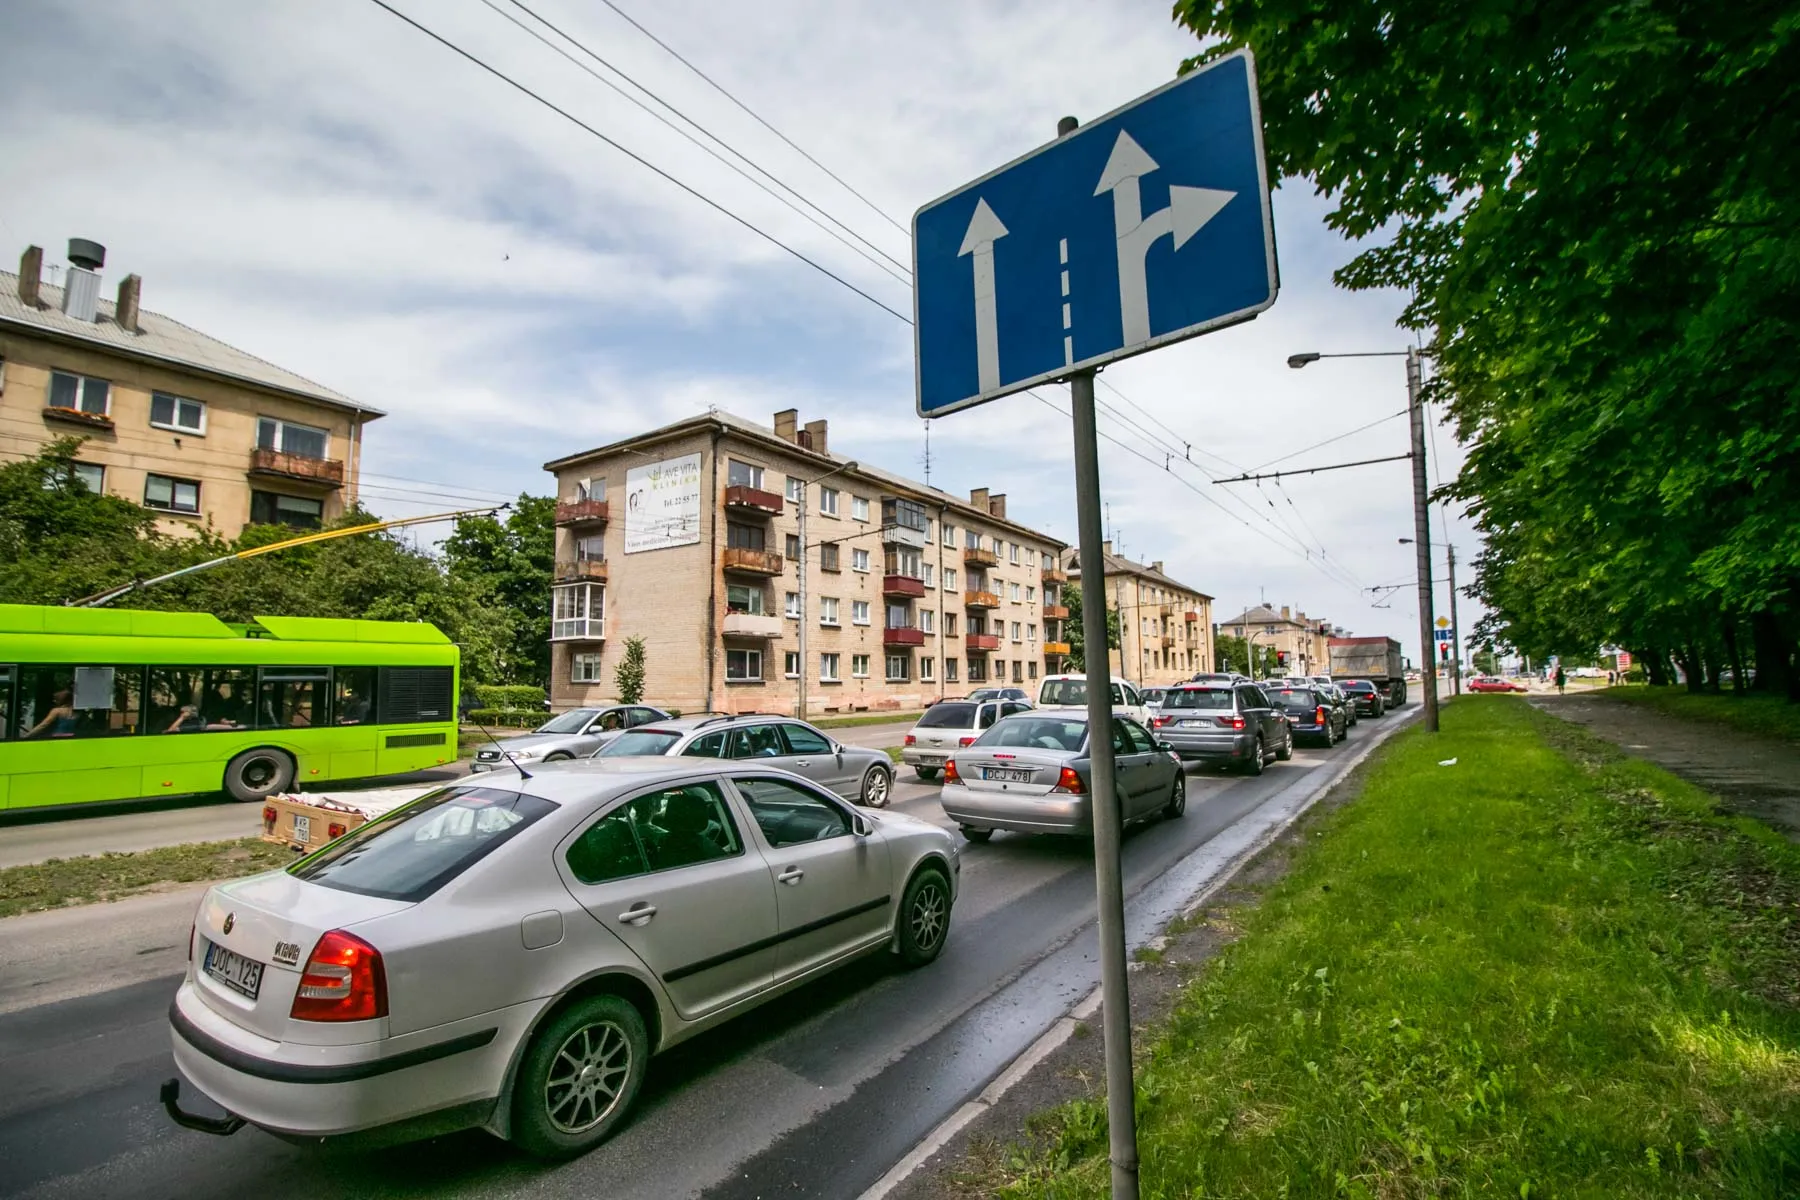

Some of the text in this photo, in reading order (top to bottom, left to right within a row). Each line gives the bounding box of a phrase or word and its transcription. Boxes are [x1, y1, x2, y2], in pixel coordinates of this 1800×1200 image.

[664, 463, 698, 479] AVE VITA
[652, 475, 698, 490] KLINIKA
[988, 769, 1029, 782] DCJ 478
[211, 945, 235, 976] DOC
[238, 959, 260, 989] 125
